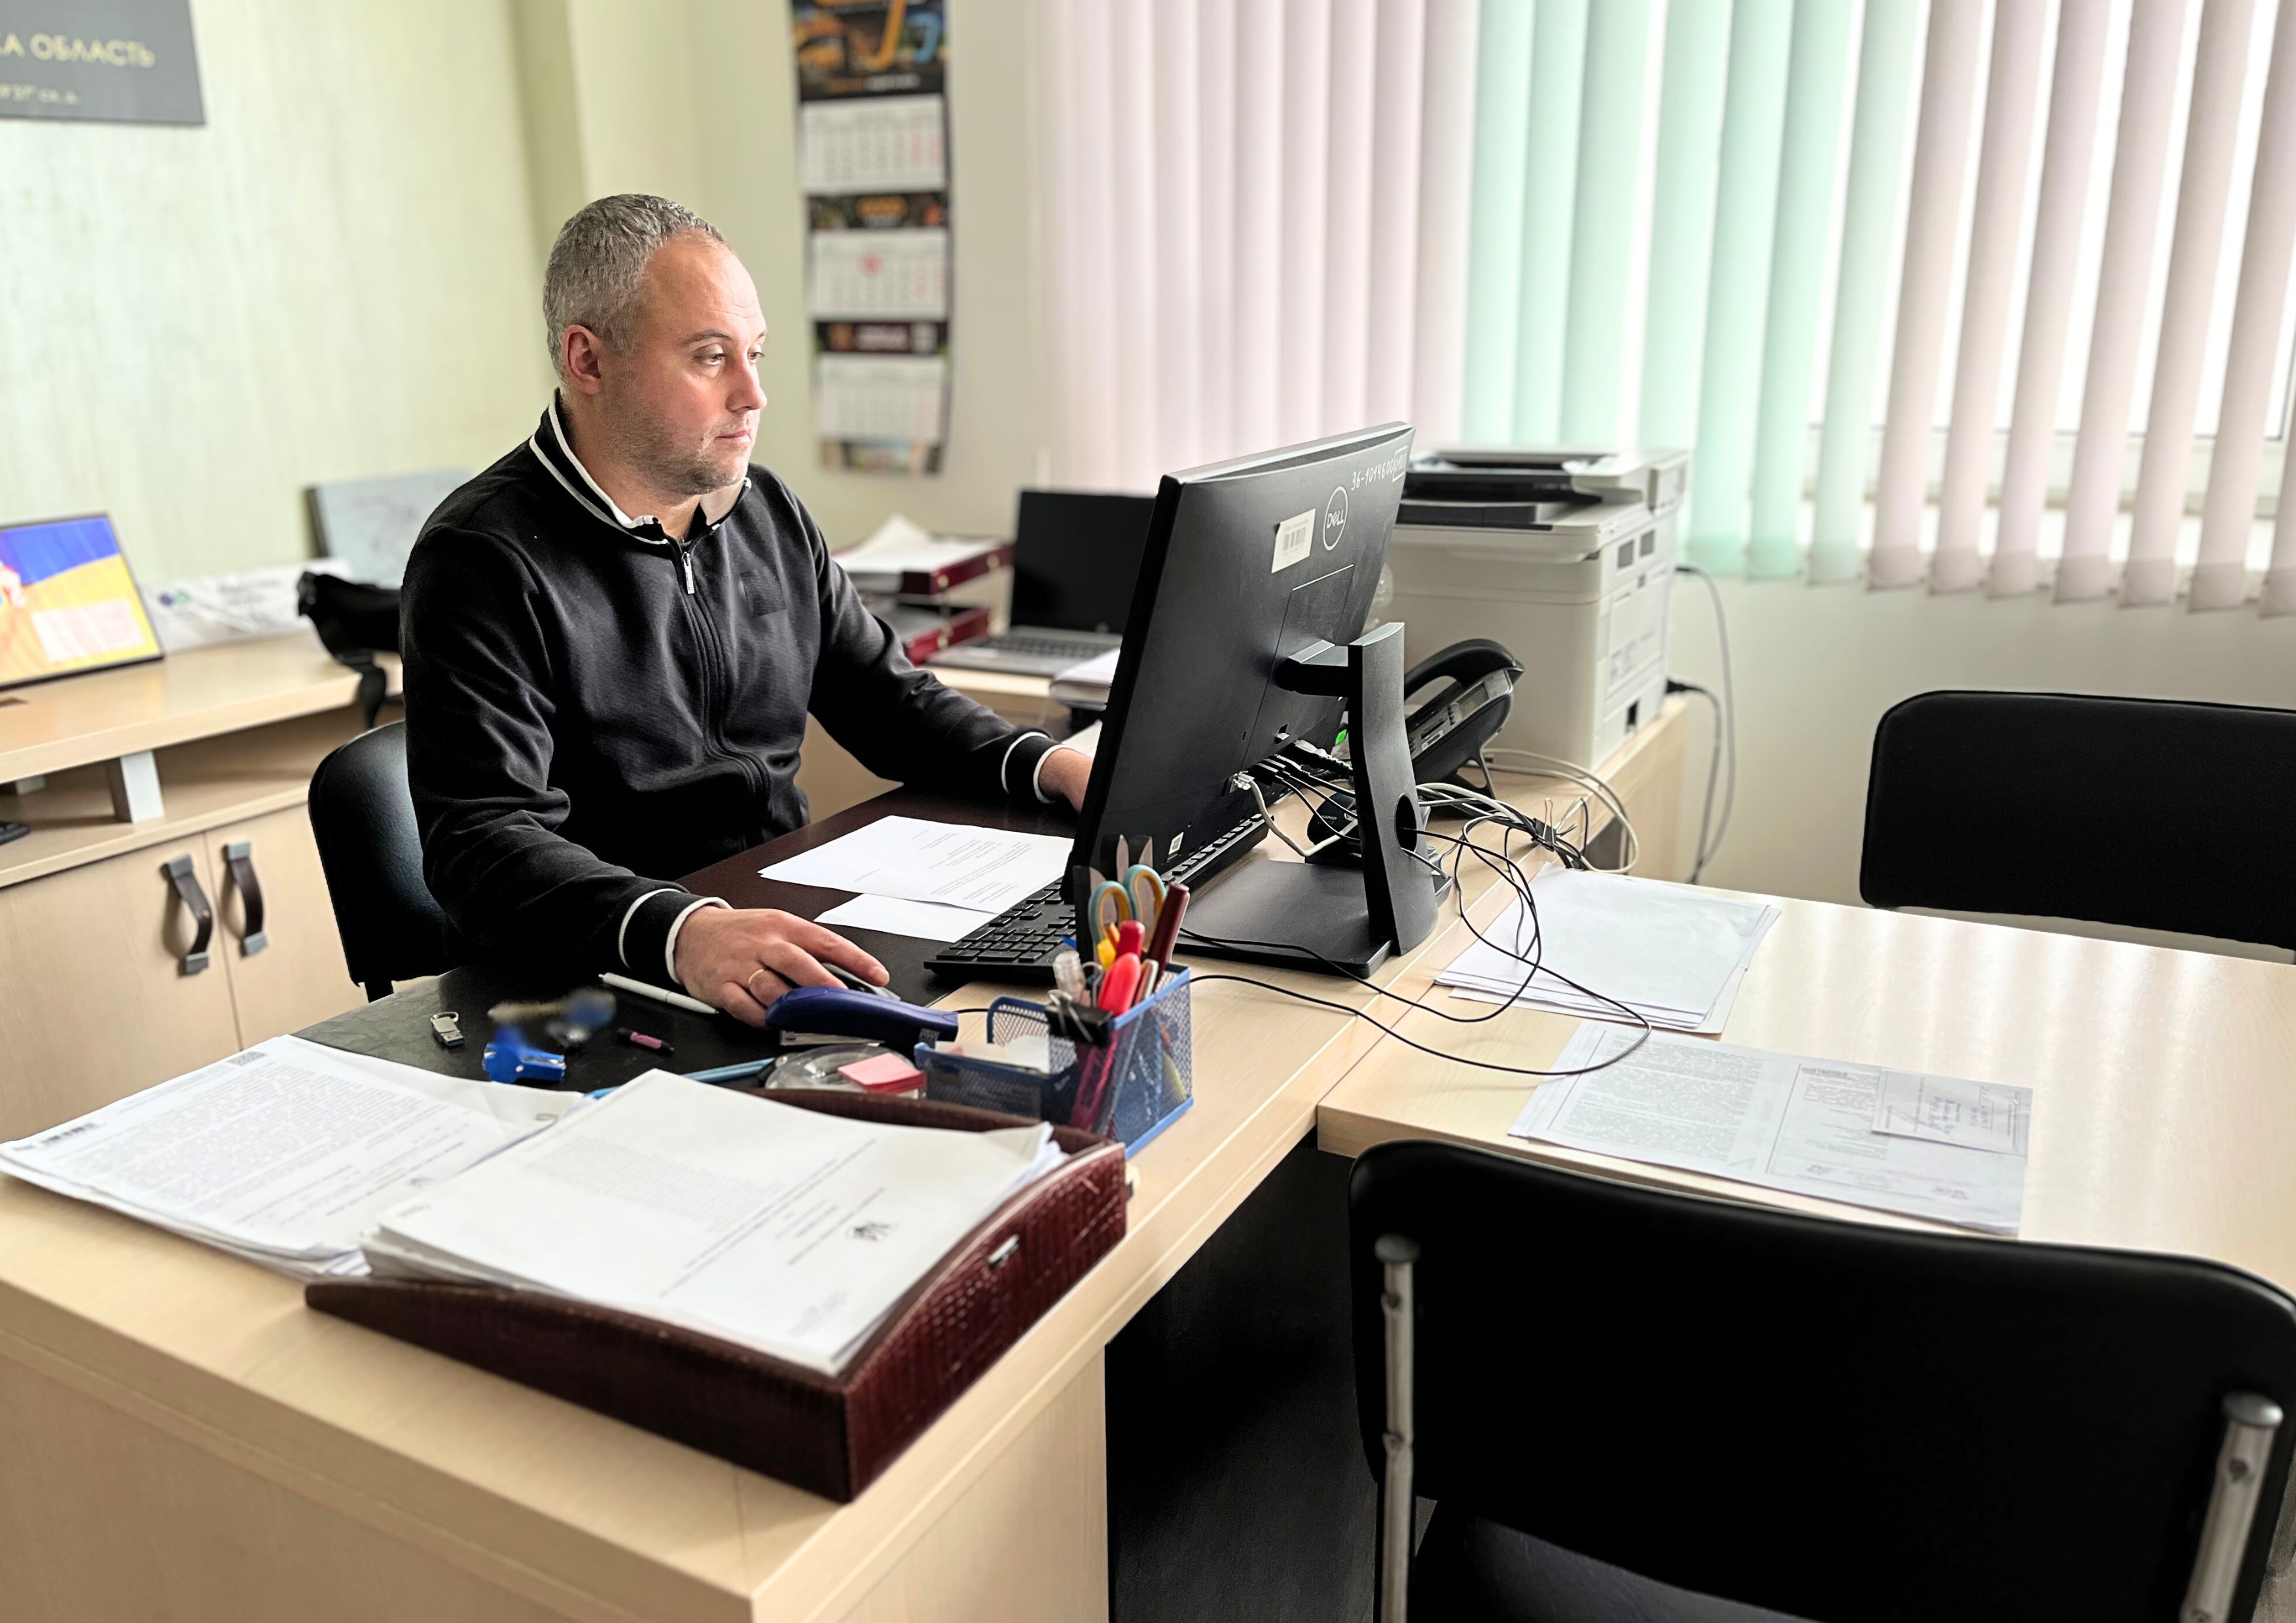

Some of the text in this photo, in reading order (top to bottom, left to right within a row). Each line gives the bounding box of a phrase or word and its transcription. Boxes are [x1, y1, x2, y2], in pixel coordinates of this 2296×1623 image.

[0, 33, 156, 67] А ОБЛАСТЬ
[1326, 509, 1344, 529] DELL
